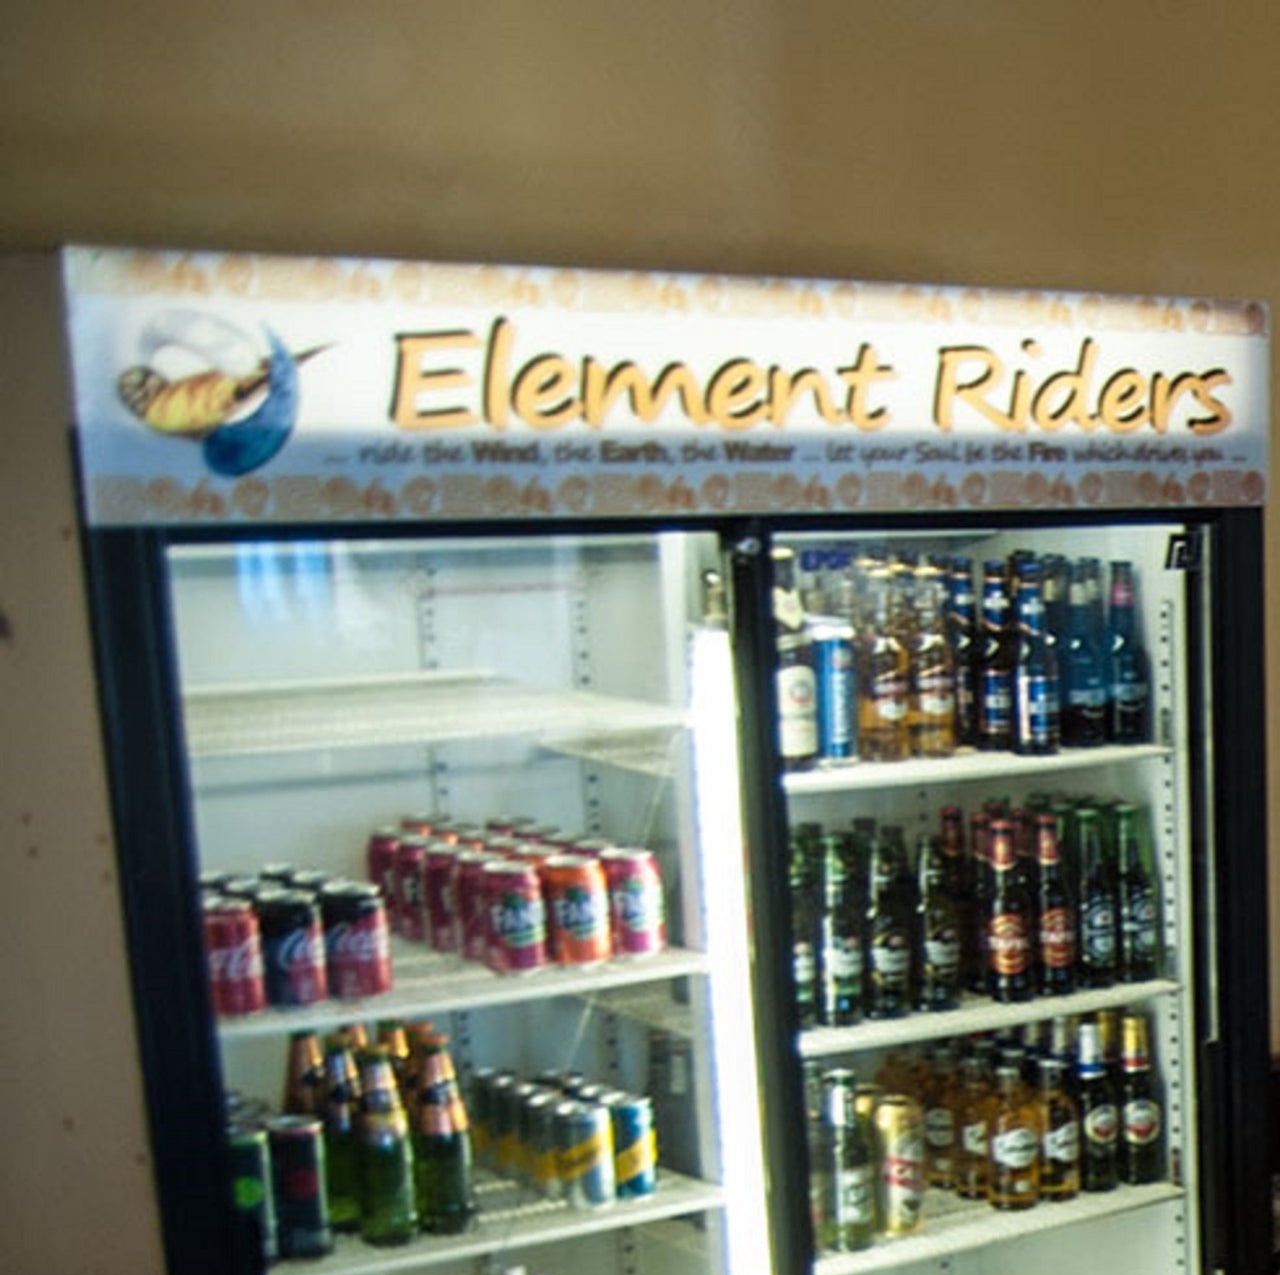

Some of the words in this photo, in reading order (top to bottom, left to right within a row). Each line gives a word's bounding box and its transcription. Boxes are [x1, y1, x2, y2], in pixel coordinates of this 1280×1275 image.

[389, 315, 894, 433] Element
[932, 336, 1234, 434] Riders
[359, 439, 415, 463] ride
[423, 438, 465, 463] the
[553, 439, 597, 463] the
[681, 441, 718, 463] the
[723, 441, 795, 463] Water
[826, 440, 855, 462] let
[860, 446, 910, 469] your
[914, 441, 961, 463] Soul
[991, 440, 1023, 462] the
[1027, 441, 1068, 462] Fire
[1072, 440, 1129, 463] which
[1189, 447, 1224, 468] you
